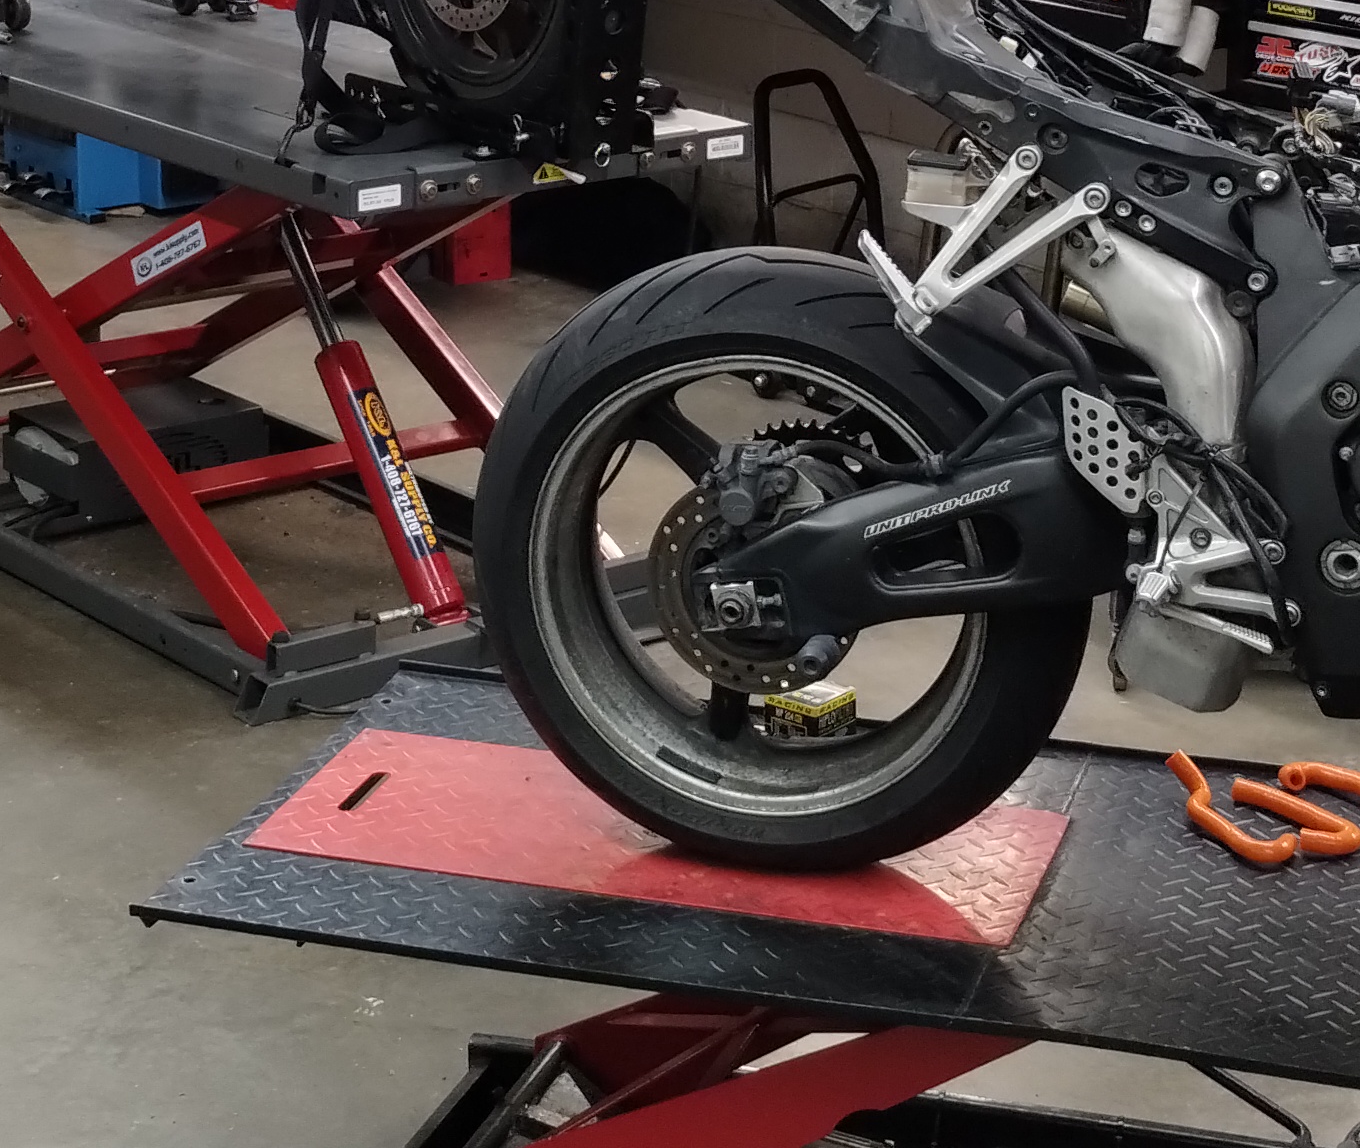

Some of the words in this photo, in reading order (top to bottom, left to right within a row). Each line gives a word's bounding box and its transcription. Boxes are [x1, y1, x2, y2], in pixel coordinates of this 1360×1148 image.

[400, 470, 429, 524] SUPPLY
[863, 512, 912, 540] UNIT
[910, 479, 1013, 523] PRO-LINK
[766, 695, 813, 715] RACING
